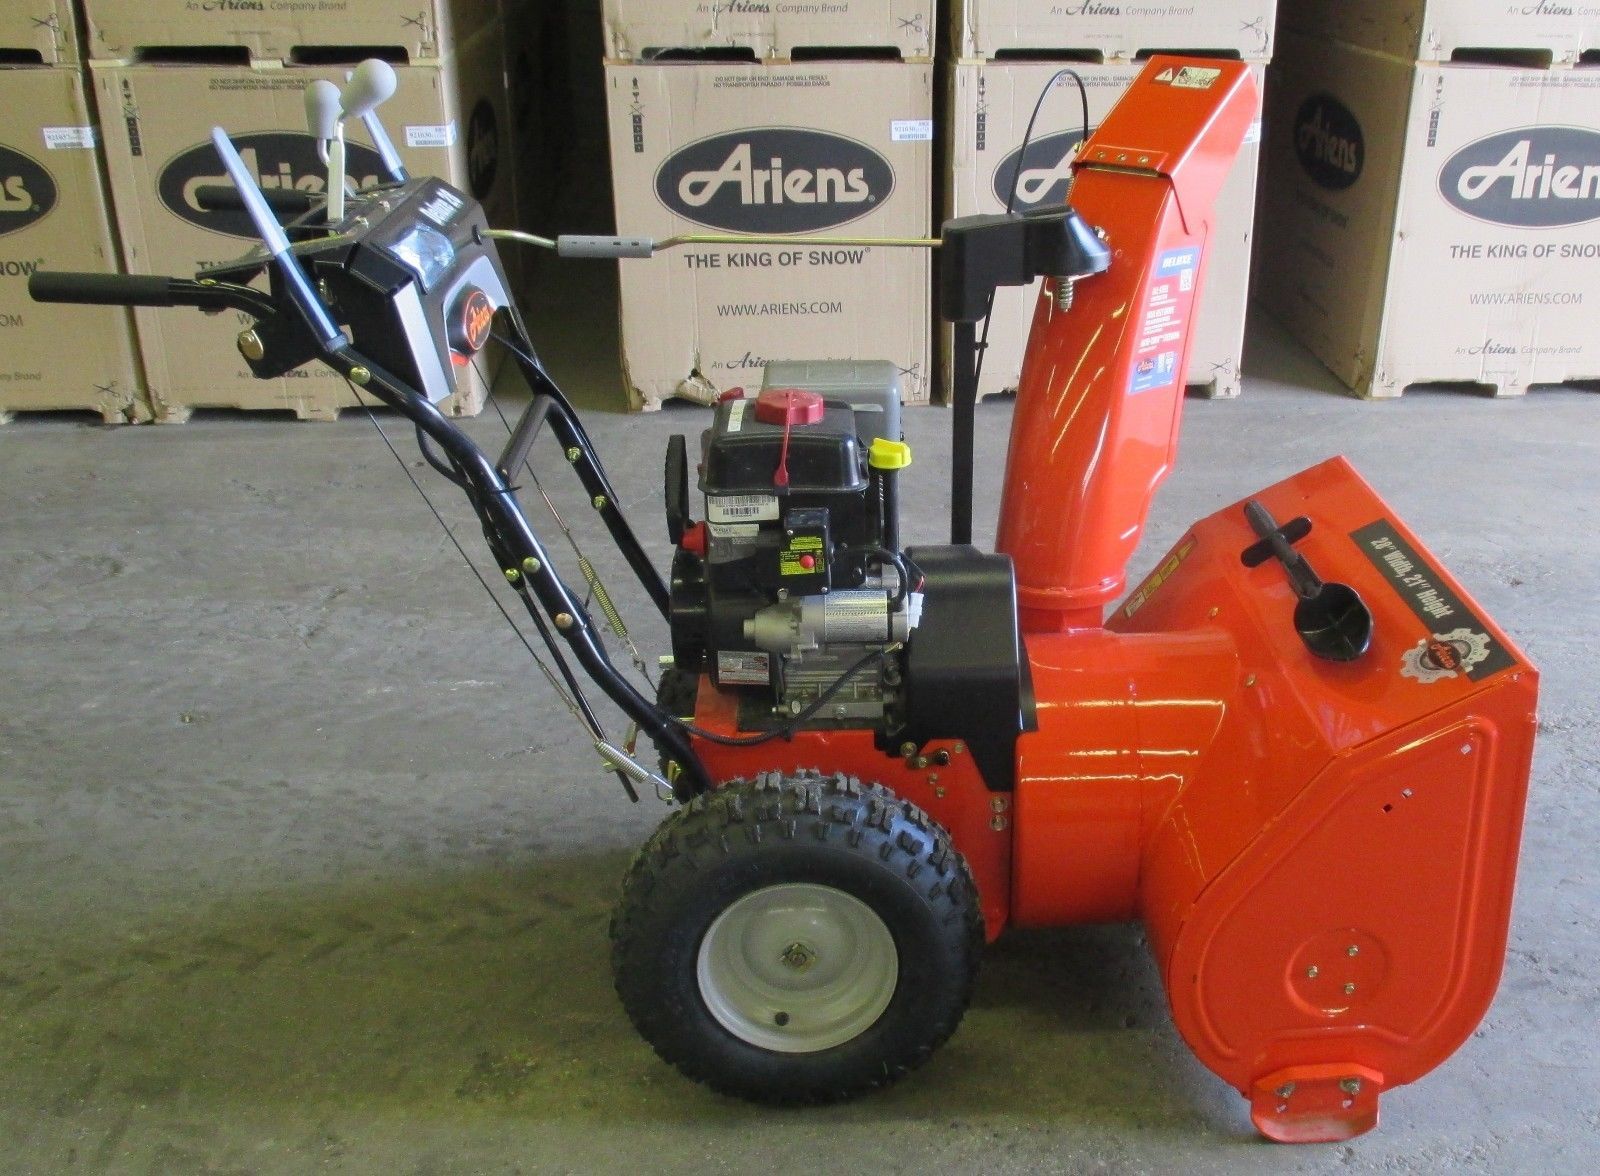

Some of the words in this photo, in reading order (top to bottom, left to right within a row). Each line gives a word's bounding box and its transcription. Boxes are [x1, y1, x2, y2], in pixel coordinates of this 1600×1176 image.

[776, 4, 819, 14] Company
[821, 3, 849, 12] Brand
[1066, 0, 1120, 15] Ariens
[1125, 6, 1166, 16] Company
[1168, 6, 1194, 15] Brand
[1522, 0, 1573, 15] Ariens
[184, 148, 378, 212] Aie
[678, 143, 869, 207] Ariens
[1450, 245, 1481, 258] THE
[1487, 245, 1527, 258] KING
[1532, 244, 1556, 258] OF
[1560, 244, 1600, 258] SNO
[684, 254, 721, 268] THE
[727, 252, 772, 267] KING
[778, 252, 803, 266] OF
[1470, 293, 1582, 304] WWW.ARIENS.COM
[717, 302, 842, 316] WWW.ARIENS.COM
[1455, 346, 1466, 354] An
[1468, 339, 1518, 354] Ariens
[1521, 346, 1557, 355] Company
[1558, 345, 1582, 353] Brand
[712, 361, 723, 369] An
[726, 352, 773, 368] Arie
[1415, 588, 1454, 619] Height
